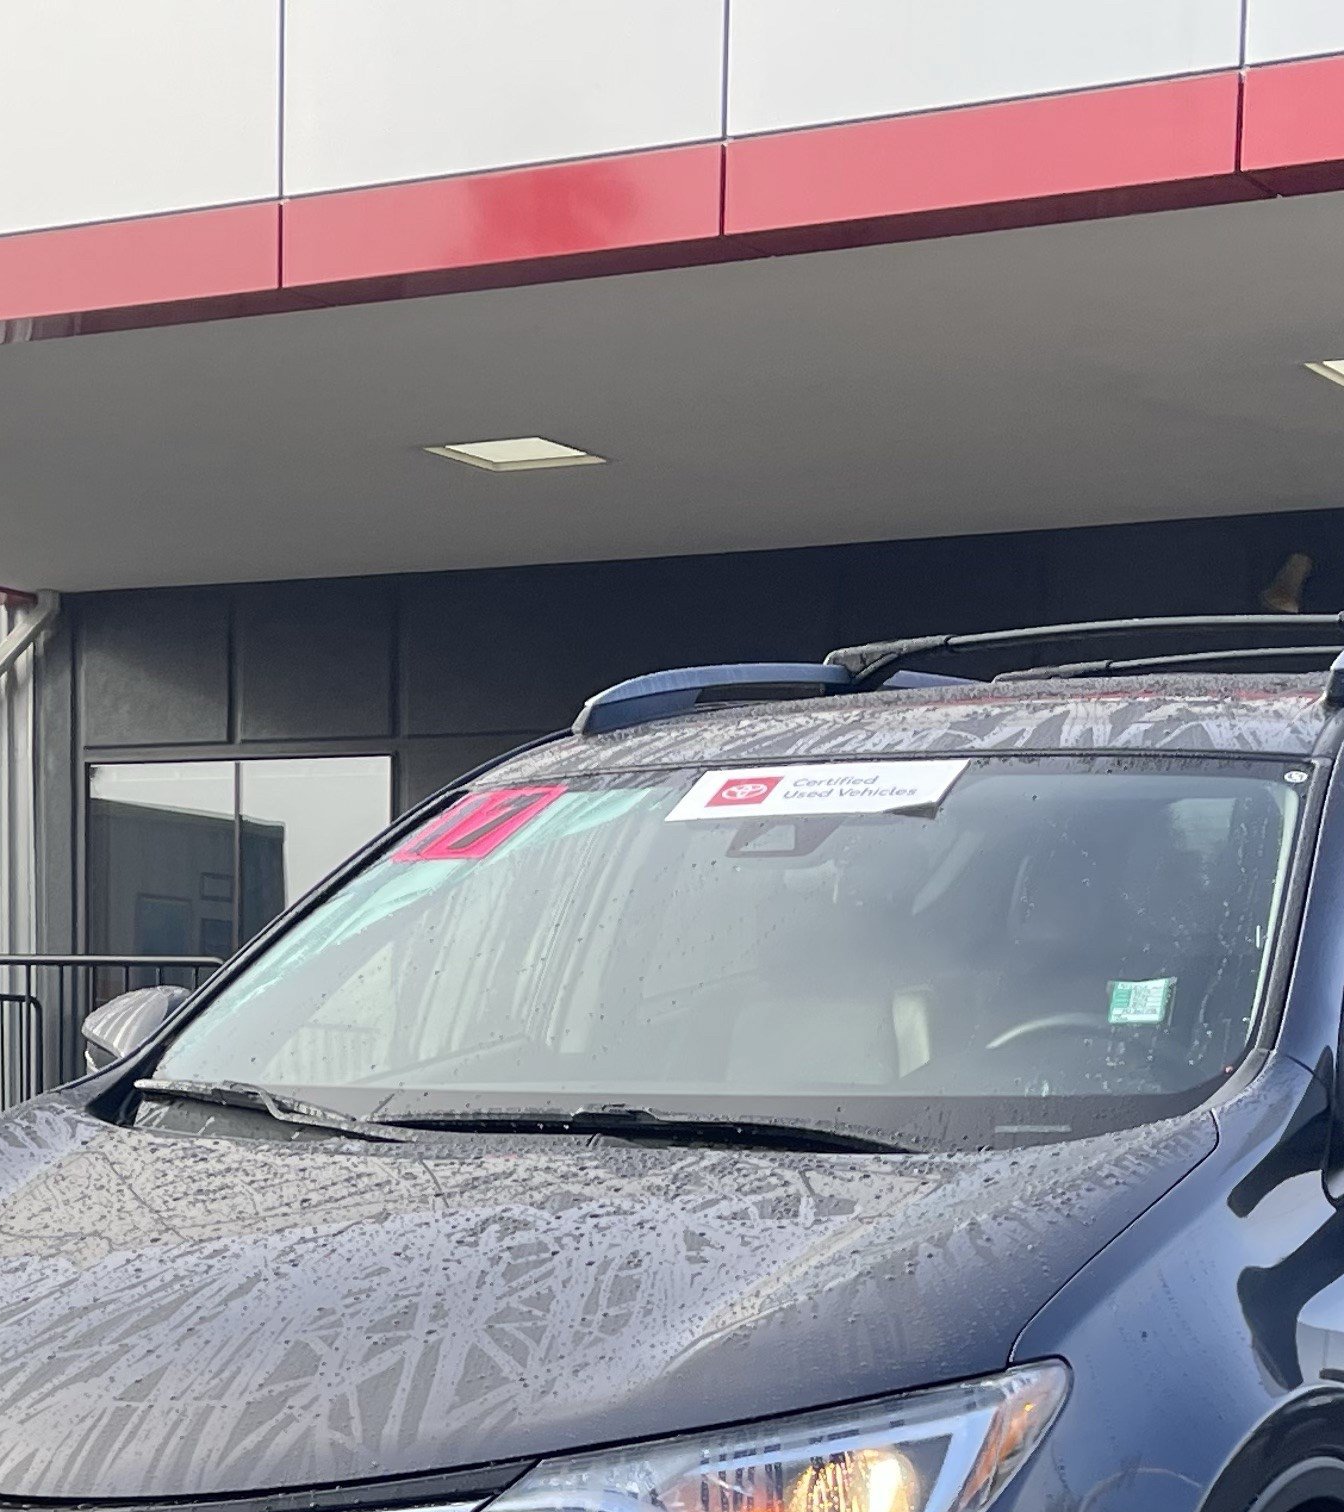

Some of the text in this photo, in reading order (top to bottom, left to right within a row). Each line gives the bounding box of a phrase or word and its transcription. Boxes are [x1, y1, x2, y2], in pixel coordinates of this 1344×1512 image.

[792, 774, 881, 788] Certified
[783, 786, 918, 799] Used Vehicles
